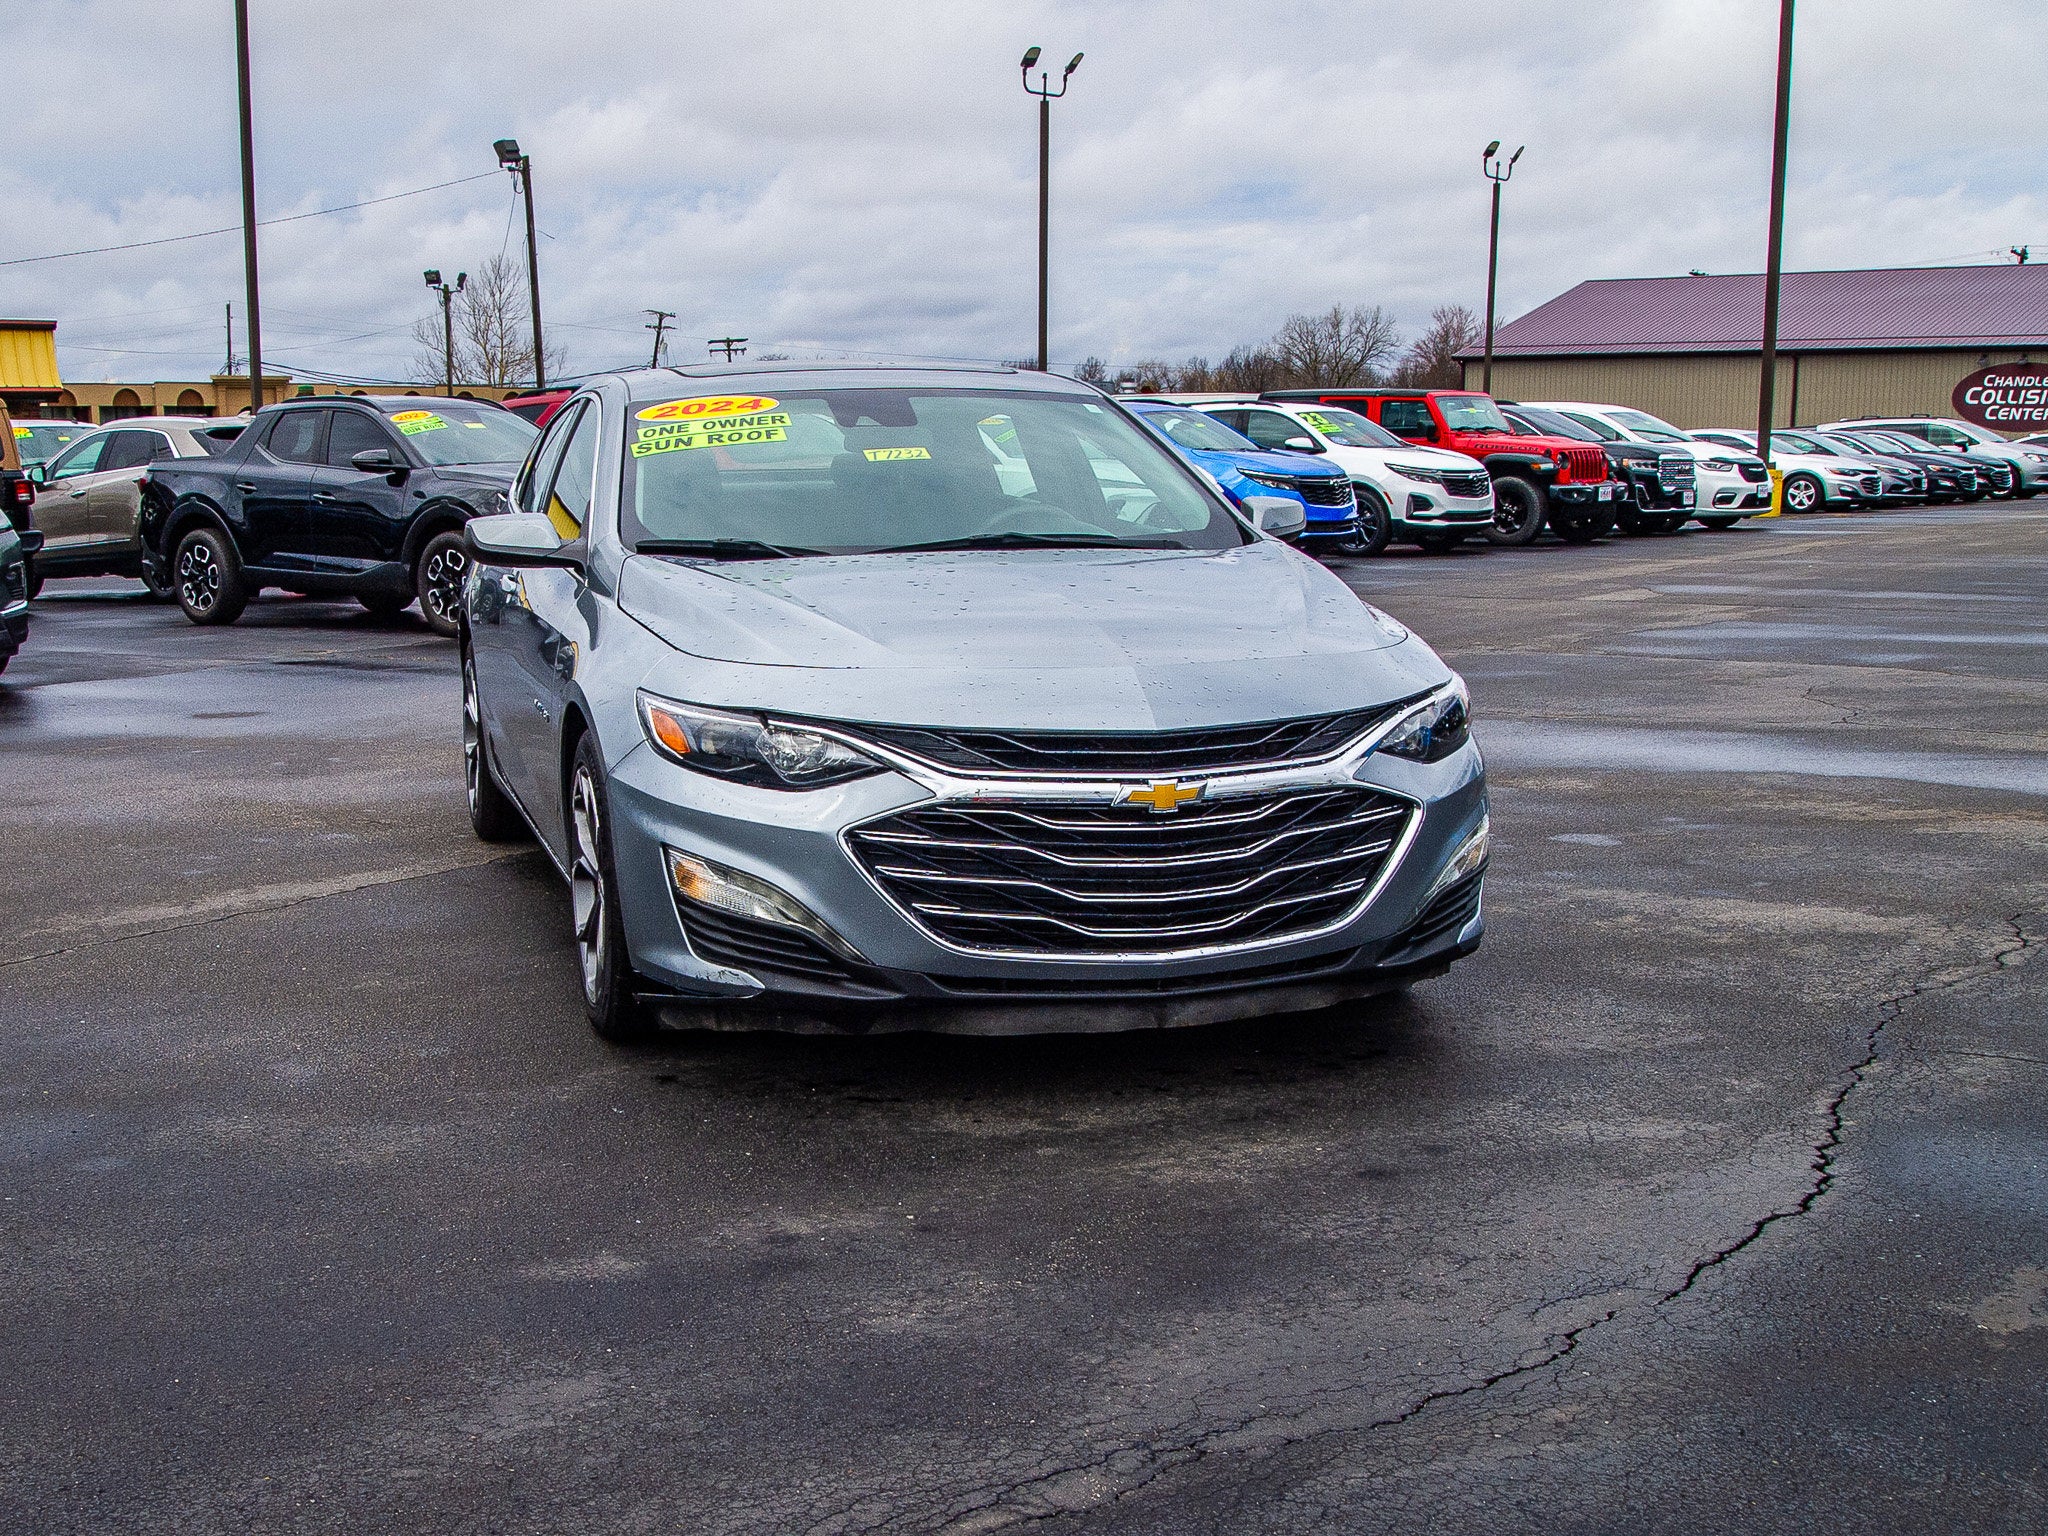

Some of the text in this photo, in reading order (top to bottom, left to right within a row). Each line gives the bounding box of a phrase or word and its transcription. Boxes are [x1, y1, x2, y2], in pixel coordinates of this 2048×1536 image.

[1964, 386, 2048, 405] COLLISI
[652, 399, 763, 419] 2024
[643, 415, 786, 438] ONE OWNER
[636, 429, 778, 454] SUN ROOF
[867, 449, 927, 461] T7232
